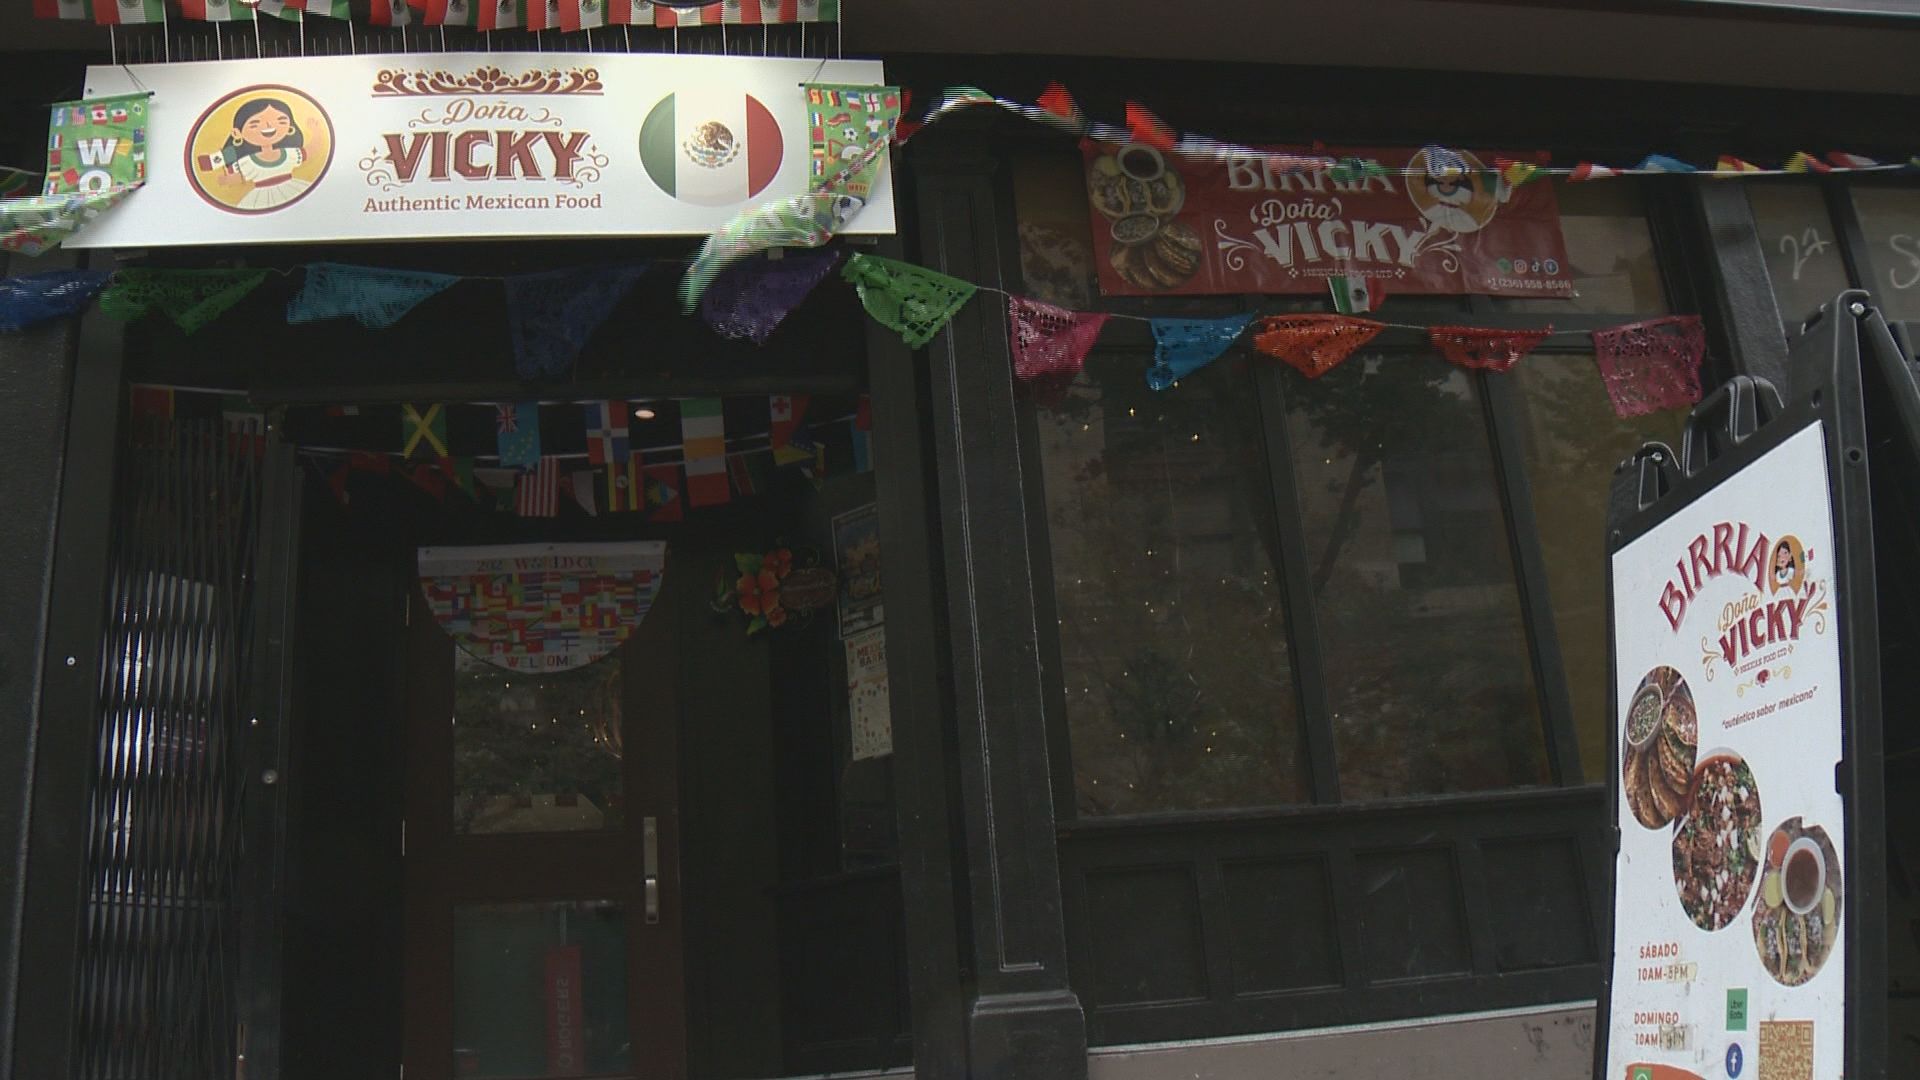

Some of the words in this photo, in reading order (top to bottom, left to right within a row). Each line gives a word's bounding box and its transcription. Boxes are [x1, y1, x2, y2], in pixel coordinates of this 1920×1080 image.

[442, 98, 529, 126] Doña
[383, 130, 591, 183] VICKY
[363, 195, 461, 212] Authentic
[465, 194, 550, 211] Mexican
[555, 194, 601, 209] Food
[1261, 198, 1335, 227] Doña
[1252, 218, 1428, 268] VICKY
[1658, 521, 1770, 634] BIRRIA
[1718, 580, 1817, 669] VICKY
[1722, 593, 1759, 632] Doña
[506, 655, 577, 669] WELOME
[1756, 703, 1777, 718] sabor
[1639, 942, 1679, 959] SÁBADO
[1634, 1012, 1679, 1025] DOMINGO
